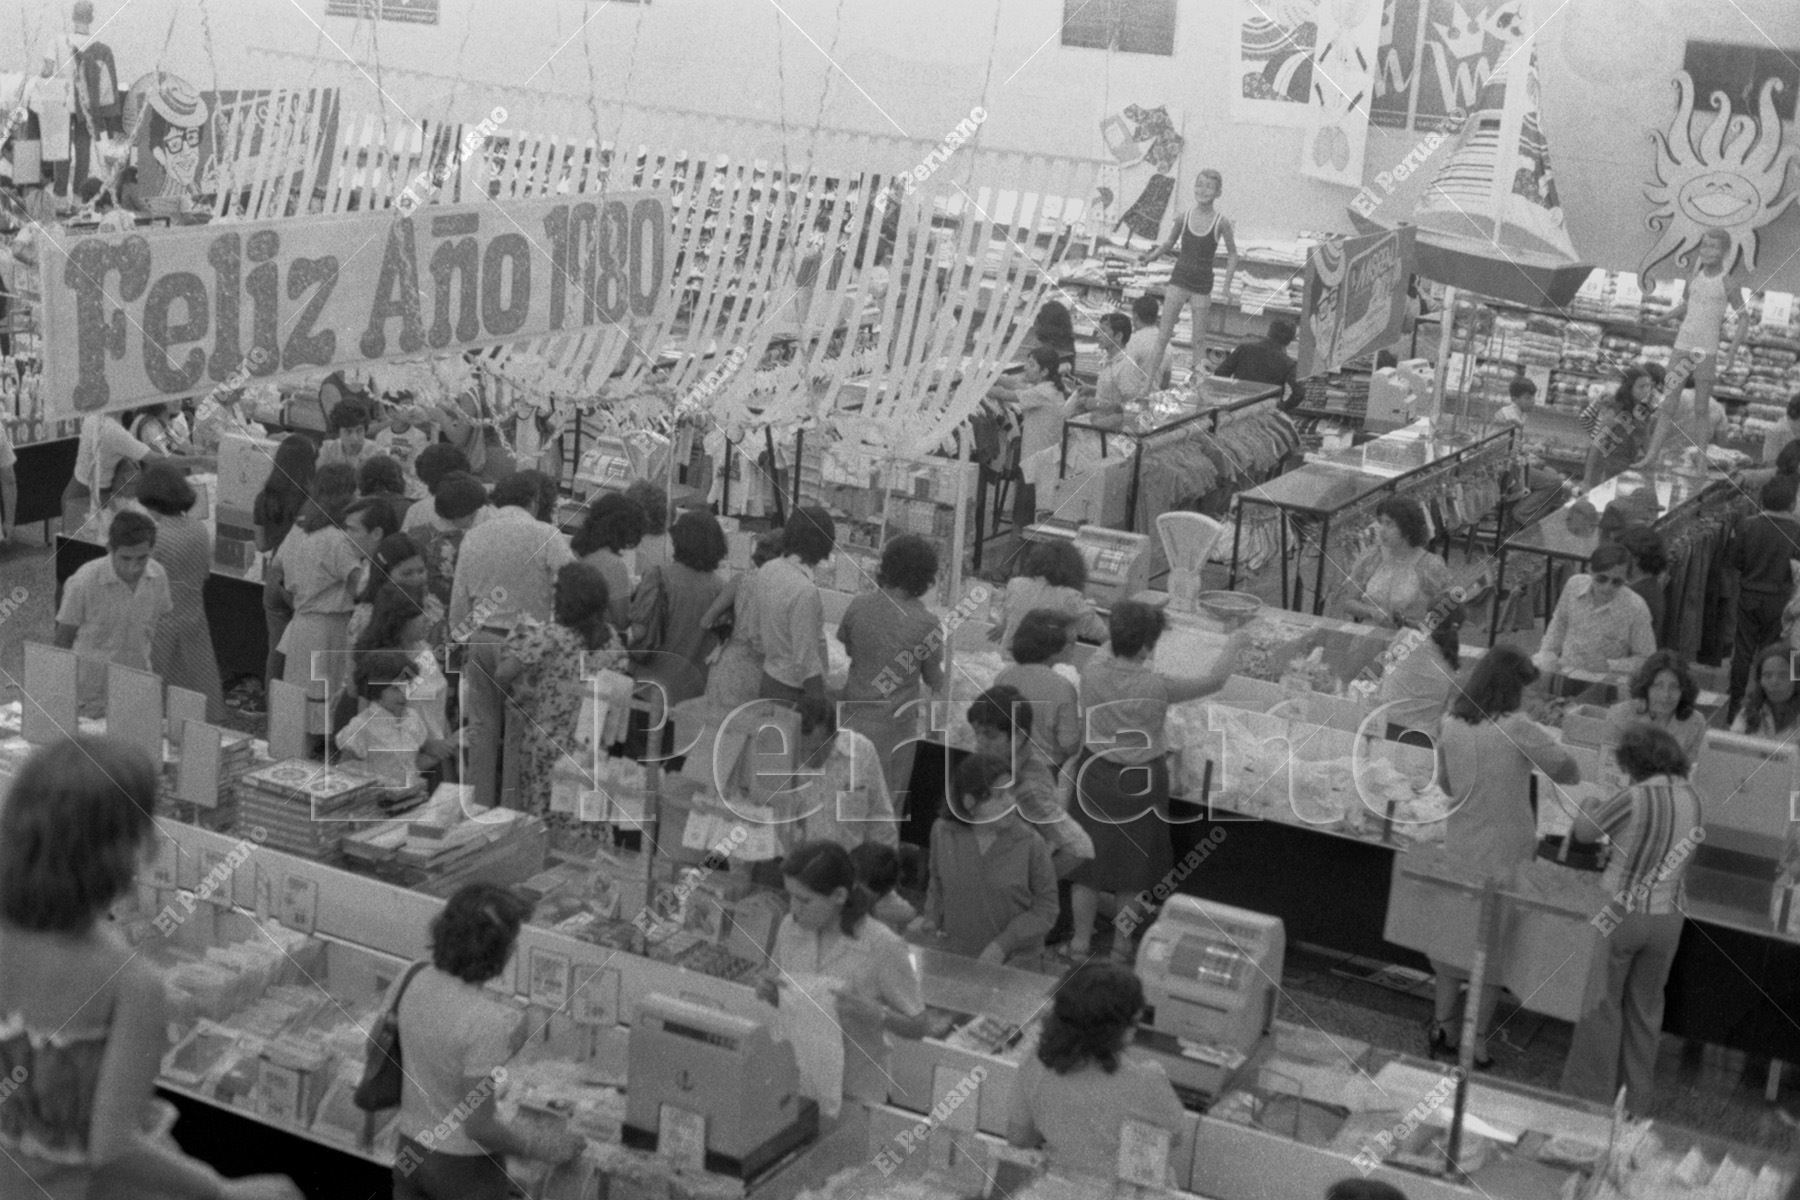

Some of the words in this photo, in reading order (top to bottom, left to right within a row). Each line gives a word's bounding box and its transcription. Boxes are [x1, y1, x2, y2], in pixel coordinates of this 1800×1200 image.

[64, 229, 339, 413] Feliz
[359, 212, 533, 359] Año
[543, 199, 665, 330] 1980
